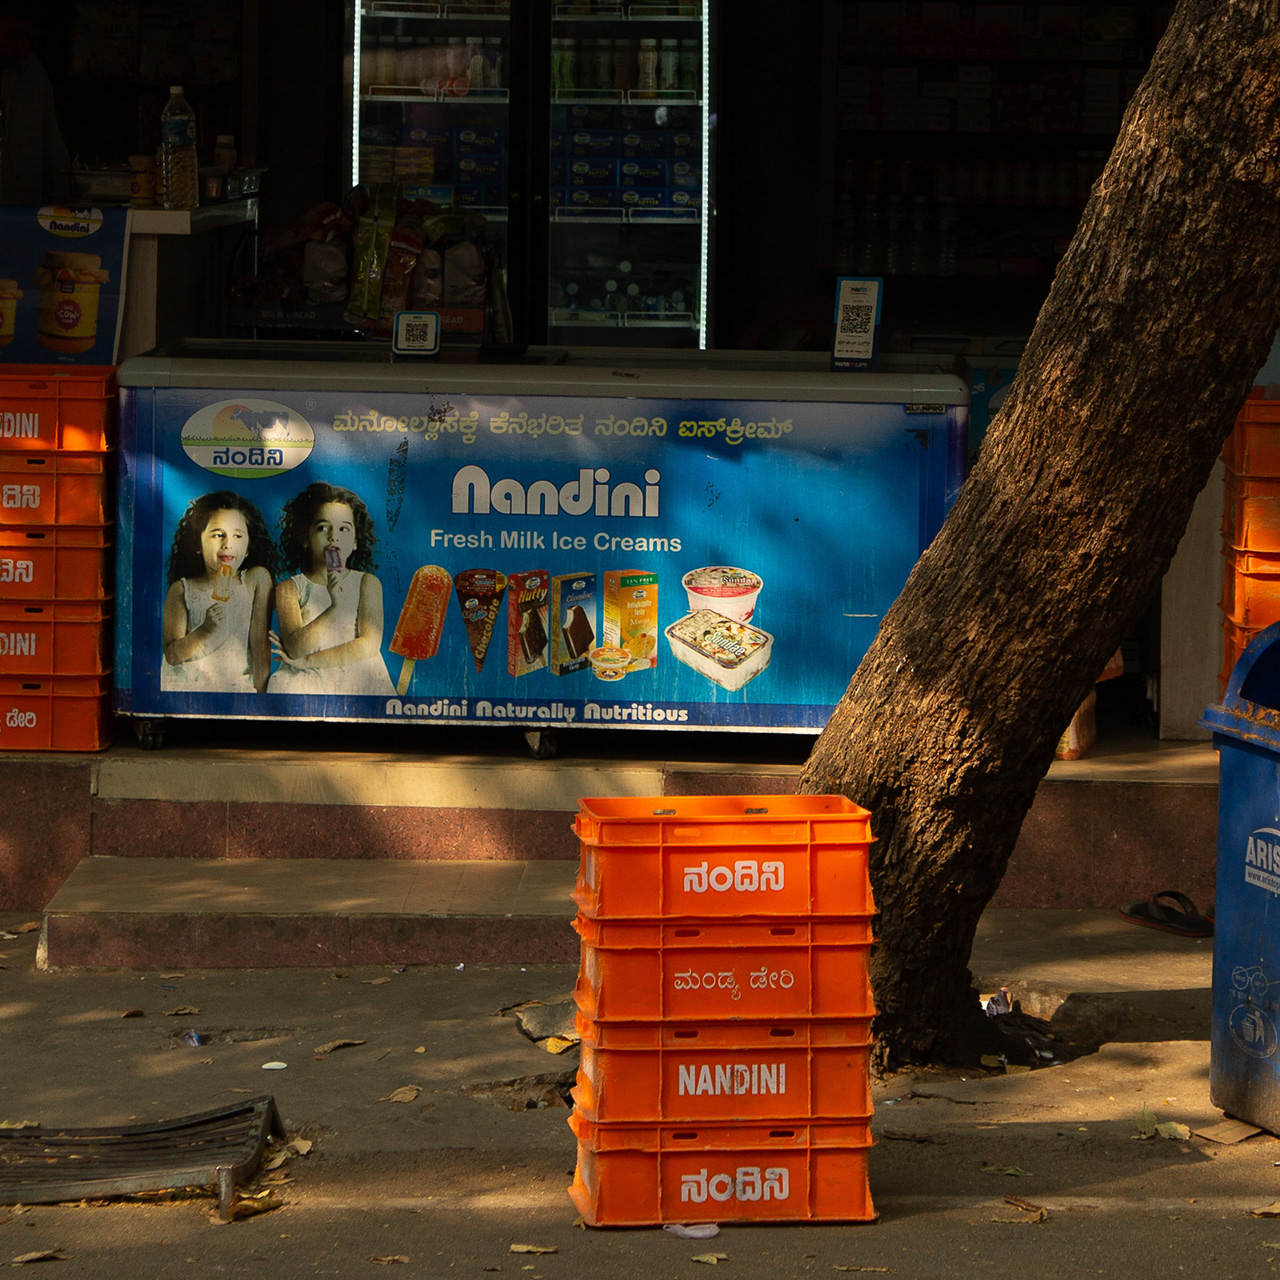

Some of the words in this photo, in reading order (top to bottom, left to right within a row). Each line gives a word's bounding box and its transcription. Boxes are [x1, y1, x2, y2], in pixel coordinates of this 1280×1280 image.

[49, 220, 91, 233] Nandini
[489, 411, 584, 437] ಕೆನೆಭರಿತ
[595, 416, 669, 438] ನಂದಿನಿ
[212, 447, 285, 468] ನಂದಿನಿ
[451, 464, 661, 517] Nandini
[429, 528, 494, 550] Fresh
[500, 528, 546, 551] Milk
[551, 531, 588, 552] Ice
[593, 532, 682, 553] Creams
[518, 588, 548, 602] Nutty
[474, 598, 500, 660] Chocolate
[706, 631, 746, 657] Sundae
[5, 709, 37, 729] ಡೇರಿ
[385, 698, 468, 717] Nandini
[476, 700, 577, 724] Naturally
[583, 703, 689, 722] Nutritious
[682, 859, 786, 894] ನಂದಿನಿ
[673, 966, 742, 1002] ಮಂಡ್ಯ
[749, 964, 796, 991] ಡೇರಿ
[677, 1062, 787, 1097] NANDINI
[680, 1165, 790, 1204] ನಂದಿನಿ
